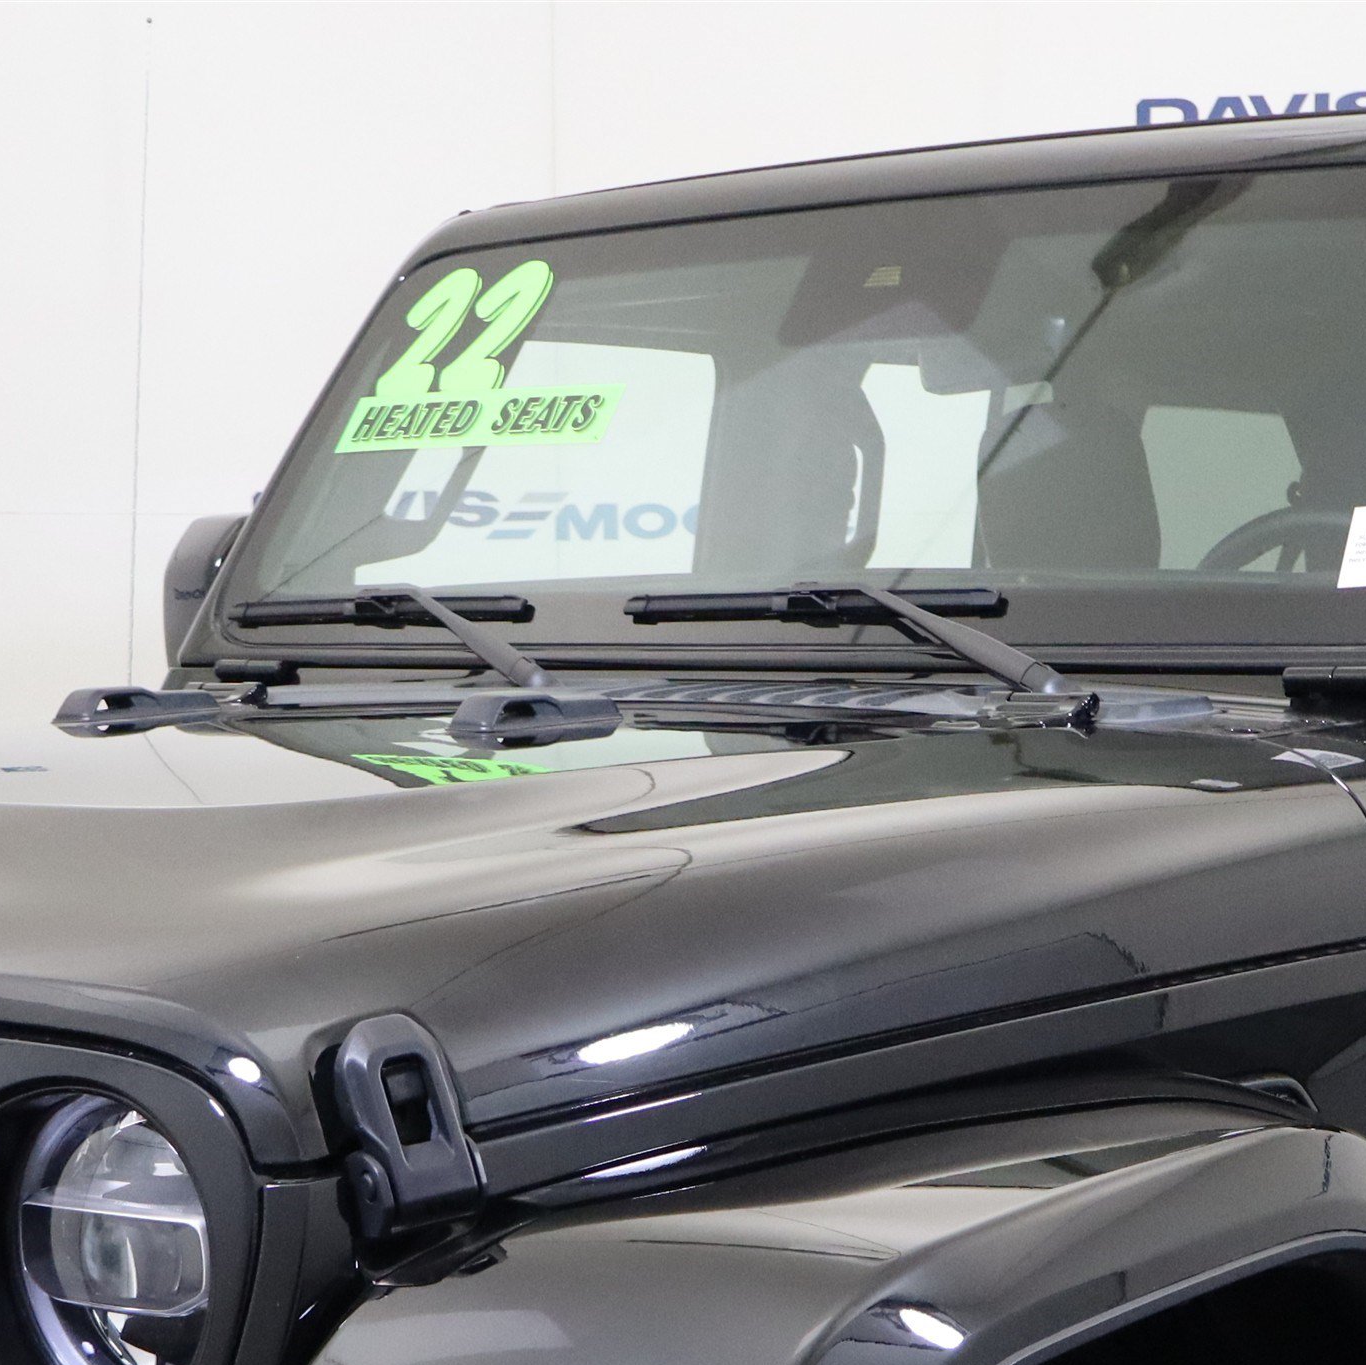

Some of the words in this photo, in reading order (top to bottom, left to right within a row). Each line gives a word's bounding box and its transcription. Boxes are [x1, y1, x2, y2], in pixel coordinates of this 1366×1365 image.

[375, 260, 554, 398] 22
[351, 401, 483, 441] HEATED
[492, 394, 605, 434] SEATS
